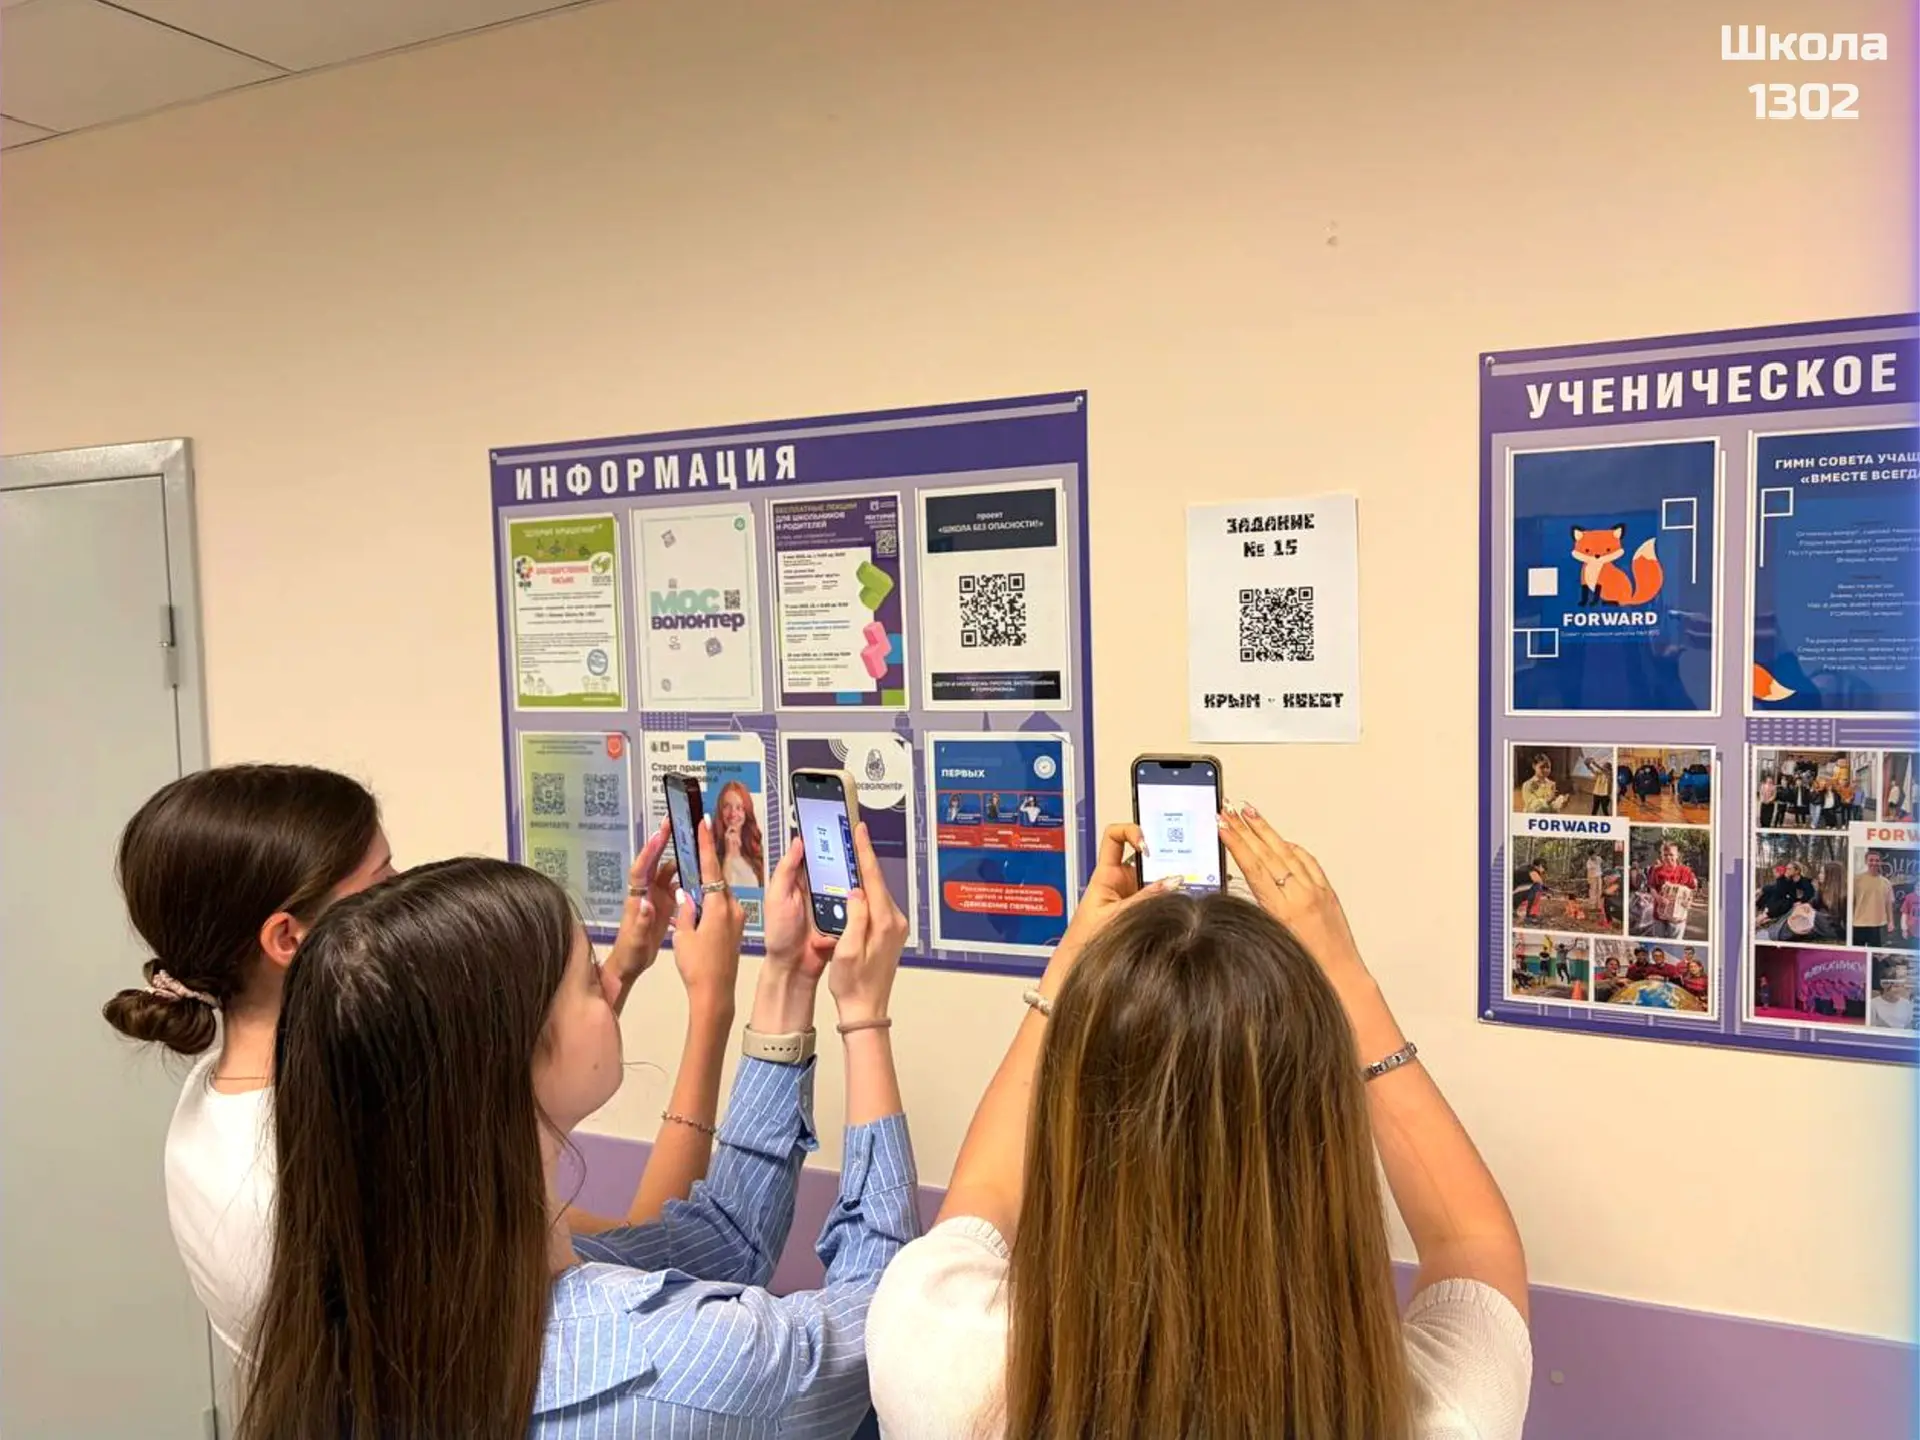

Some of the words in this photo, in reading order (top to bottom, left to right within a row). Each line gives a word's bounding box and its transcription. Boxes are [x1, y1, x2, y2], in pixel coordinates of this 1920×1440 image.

[1526, 352, 1898, 420] УЧЕНИЧЕСКОЕ
[1774, 459, 1815, 470] ГИМН
[1818, 454, 1874, 468] СОВЕТА
[515, 445, 797, 501] ИНФОРМАЦИЯ
[1800, 470, 1869, 485] «ВМЕСТЕ
[1871, 467, 1920, 481] ВСЕГД
[976, 511, 1004, 521] проект
[1226, 513, 1316, 534] ЗАДАНИЕ
[973, 522, 987, 532] БЕЗ
[1243, 541, 1265, 558] №
[1273, 539, 1299, 556] 15
[1562, 610, 1658, 627] FORWARD
[1203, 692, 1262, 709] КРЫМ
[1282, 692, 1345, 709] КВЕСТ
[651, 762, 677, 773] Старт
[941, 768, 986, 779] ПЕРВЫХ
[1528, 818, 1612, 834] FORWARD
